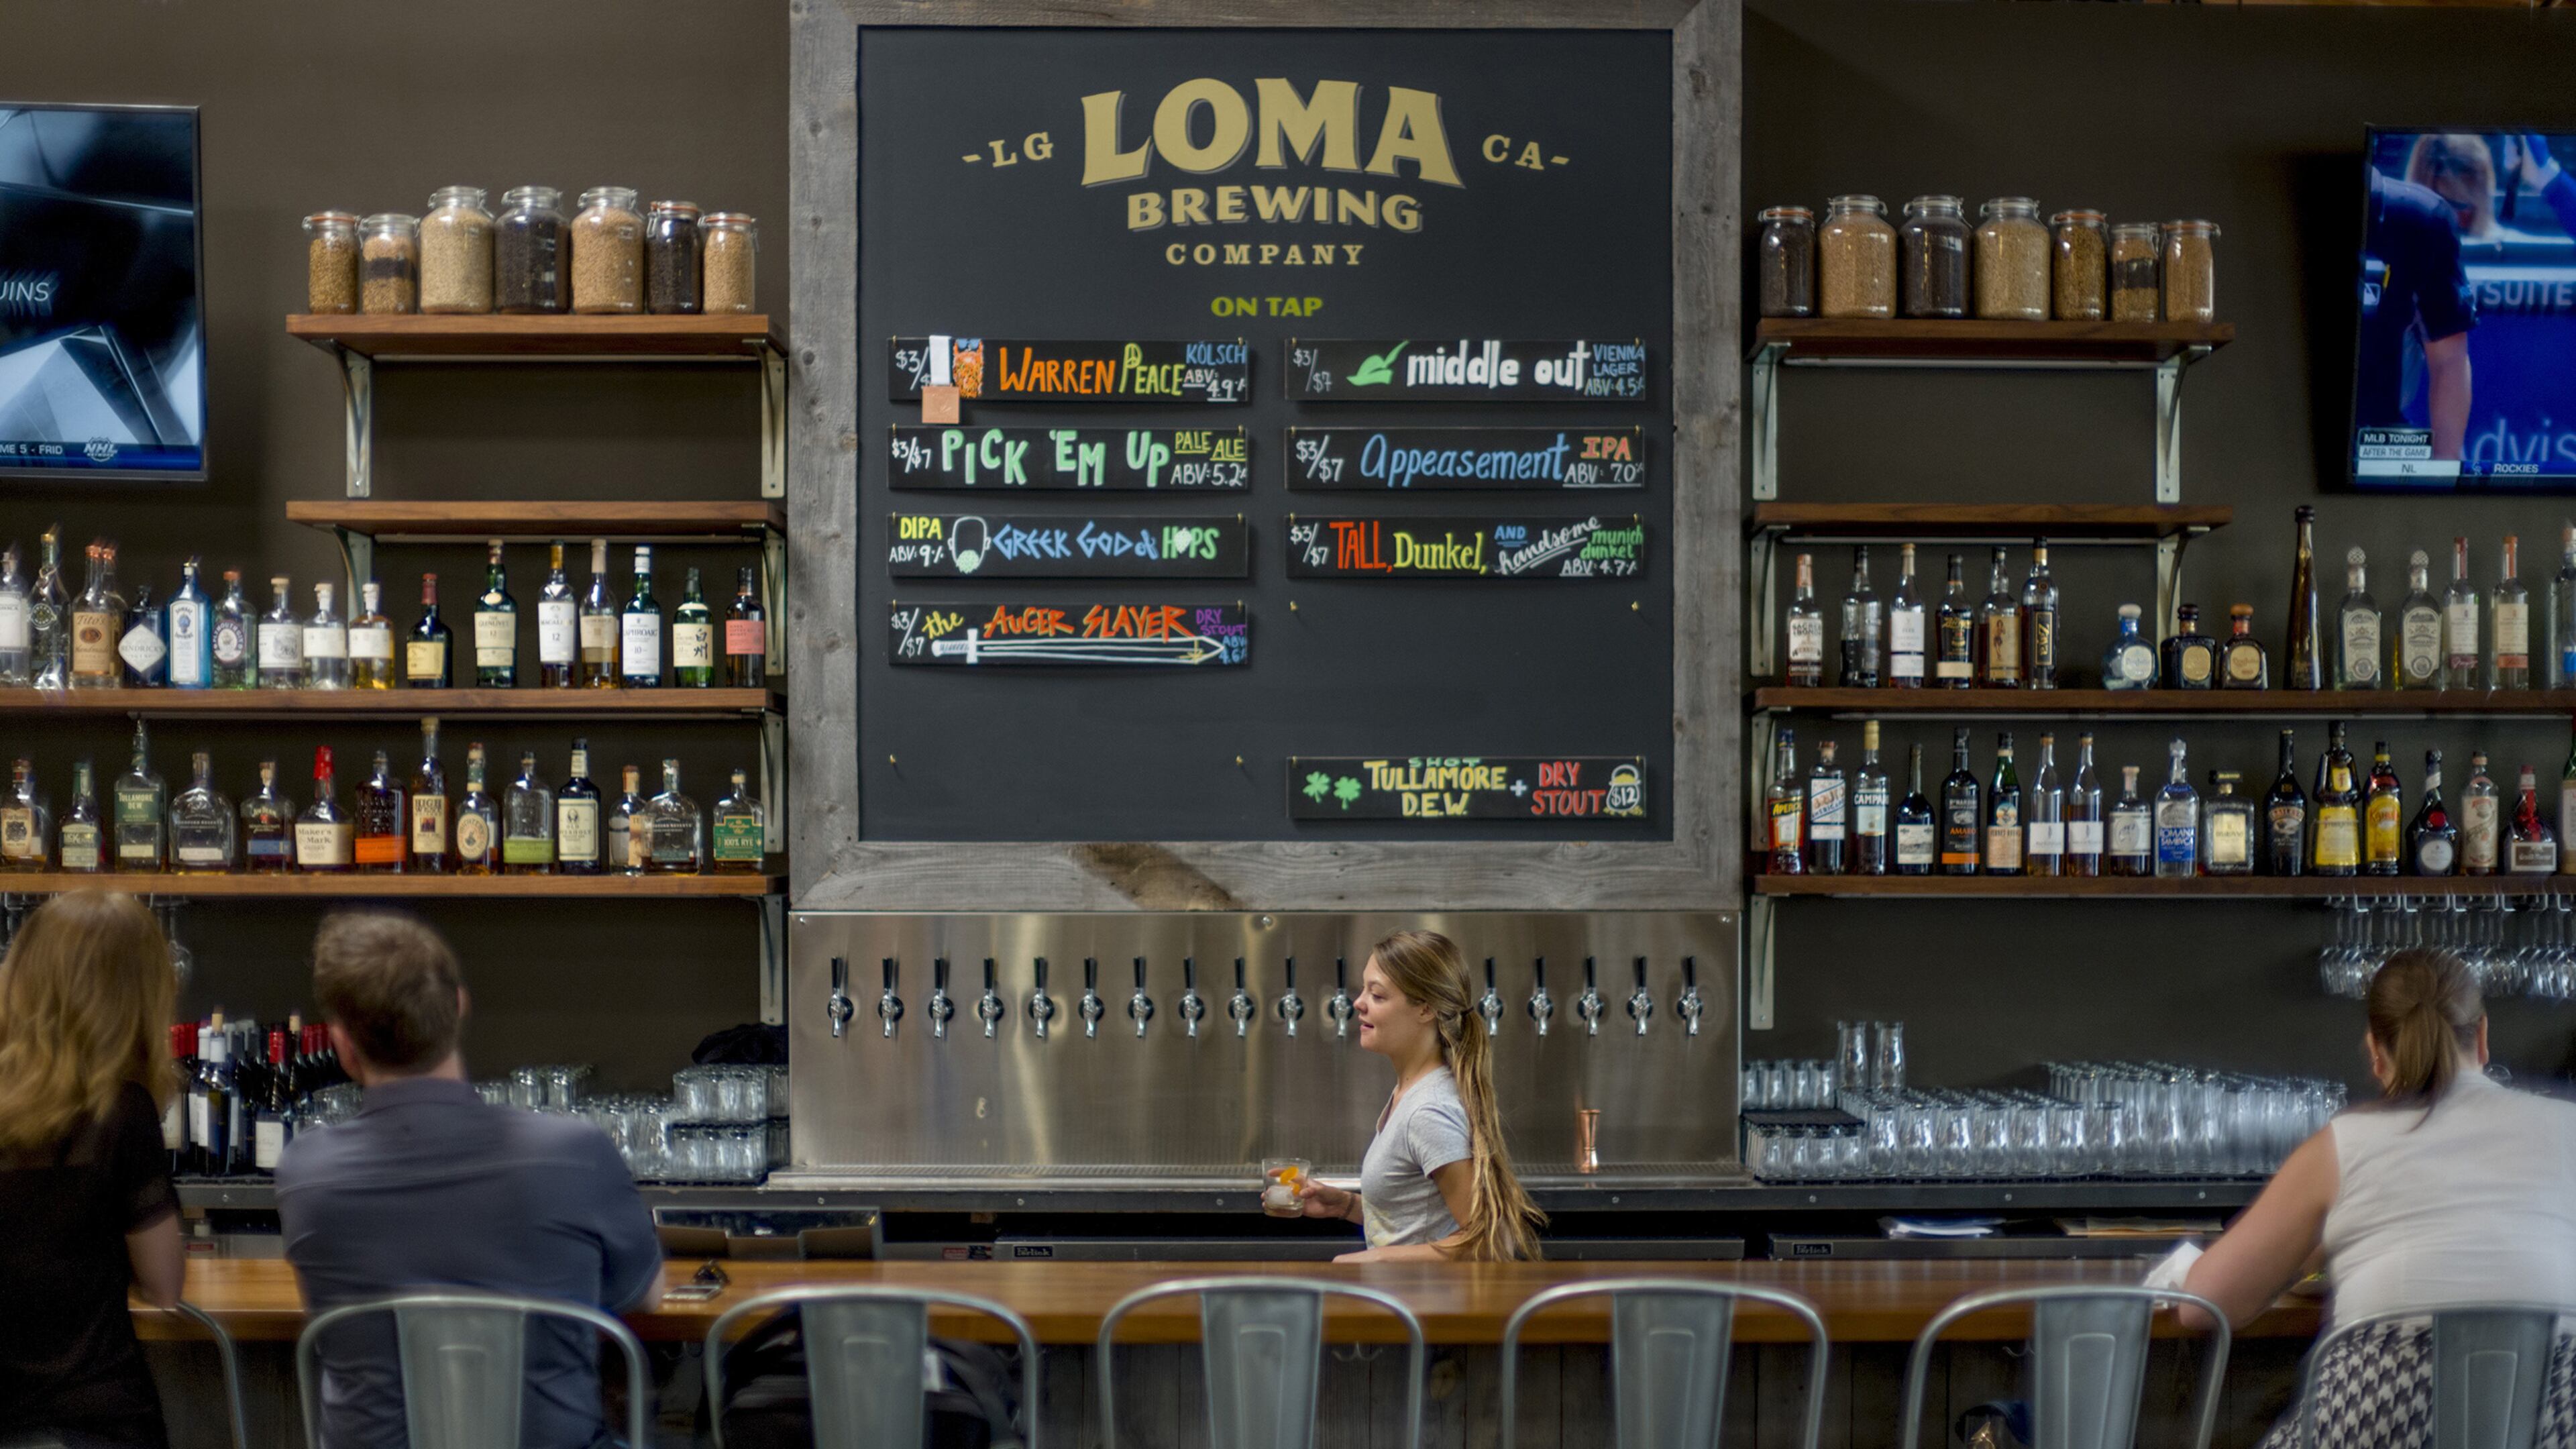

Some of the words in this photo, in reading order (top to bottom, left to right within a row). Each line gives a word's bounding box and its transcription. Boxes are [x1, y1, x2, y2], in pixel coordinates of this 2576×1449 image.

[1080, 78, 1466, 189] LOMA
[1127, 184, 1423, 233] BREWING
[1165, 243, 1365, 266] COMPANY
[1210, 296, 1258, 317] ON
[1265, 296, 1324, 317] TAP
[1593, 343, 1645, 362] VIENNA
[1000, 347, 1116, 394] WARREN
[1119, 343, 1185, 396] PEACE
[1407, 339, 1519, 389] middle
[1534, 340, 1591, 390] out
[1593, 362, 1639, 377] LAGER
[19, 445, 26, 453] 5
[83, 443, 117, 453] NHL
[1174, 431, 1213, 451] PALE
[1210, 438, 1246, 460] ALE
[1580, 436, 1631, 462] IPA
[2364, 434, 2385, 443] MLB
[2389, 434, 2428, 444] TONIGHT
[942, 429, 1030, 486] PICK
[1126, 430, 1170, 488] UP
[1360, 433, 1570, 488] Appeasement
[2363, 447, 2386, 457] AFTER
[2389, 448, 2403, 457] THE
[2404, 448, 2427, 457] GAME
[2402, 464, 2416, 474] NL
[2493, 463, 2539, 474] ROCKIES
[900, 516, 942, 540] DIPA
[1494, 525, 1527, 540] AND
[993, 523, 1072, 560] GREEK
[1076, 521, 1134, 559] GOD
[1494, 516, 1601, 576] handsome
[921, 609, 963, 639] the
[1082, 604, 1196, 643] SLAYER
[1196, 608, 1222, 625] DRY
[552, 633, 560, 642] 12
[1200, 624, 1246, 637] STOUT
[1409, 757, 1481, 767] SHOT
[1362, 759, 1507, 791] TULLAMORE
[1539, 761, 1580, 788] DRY
[1531, 790, 1606, 815] STOUT
[1611, 787, 1635, 807] $12
[741, 838, 754, 847] RYE
